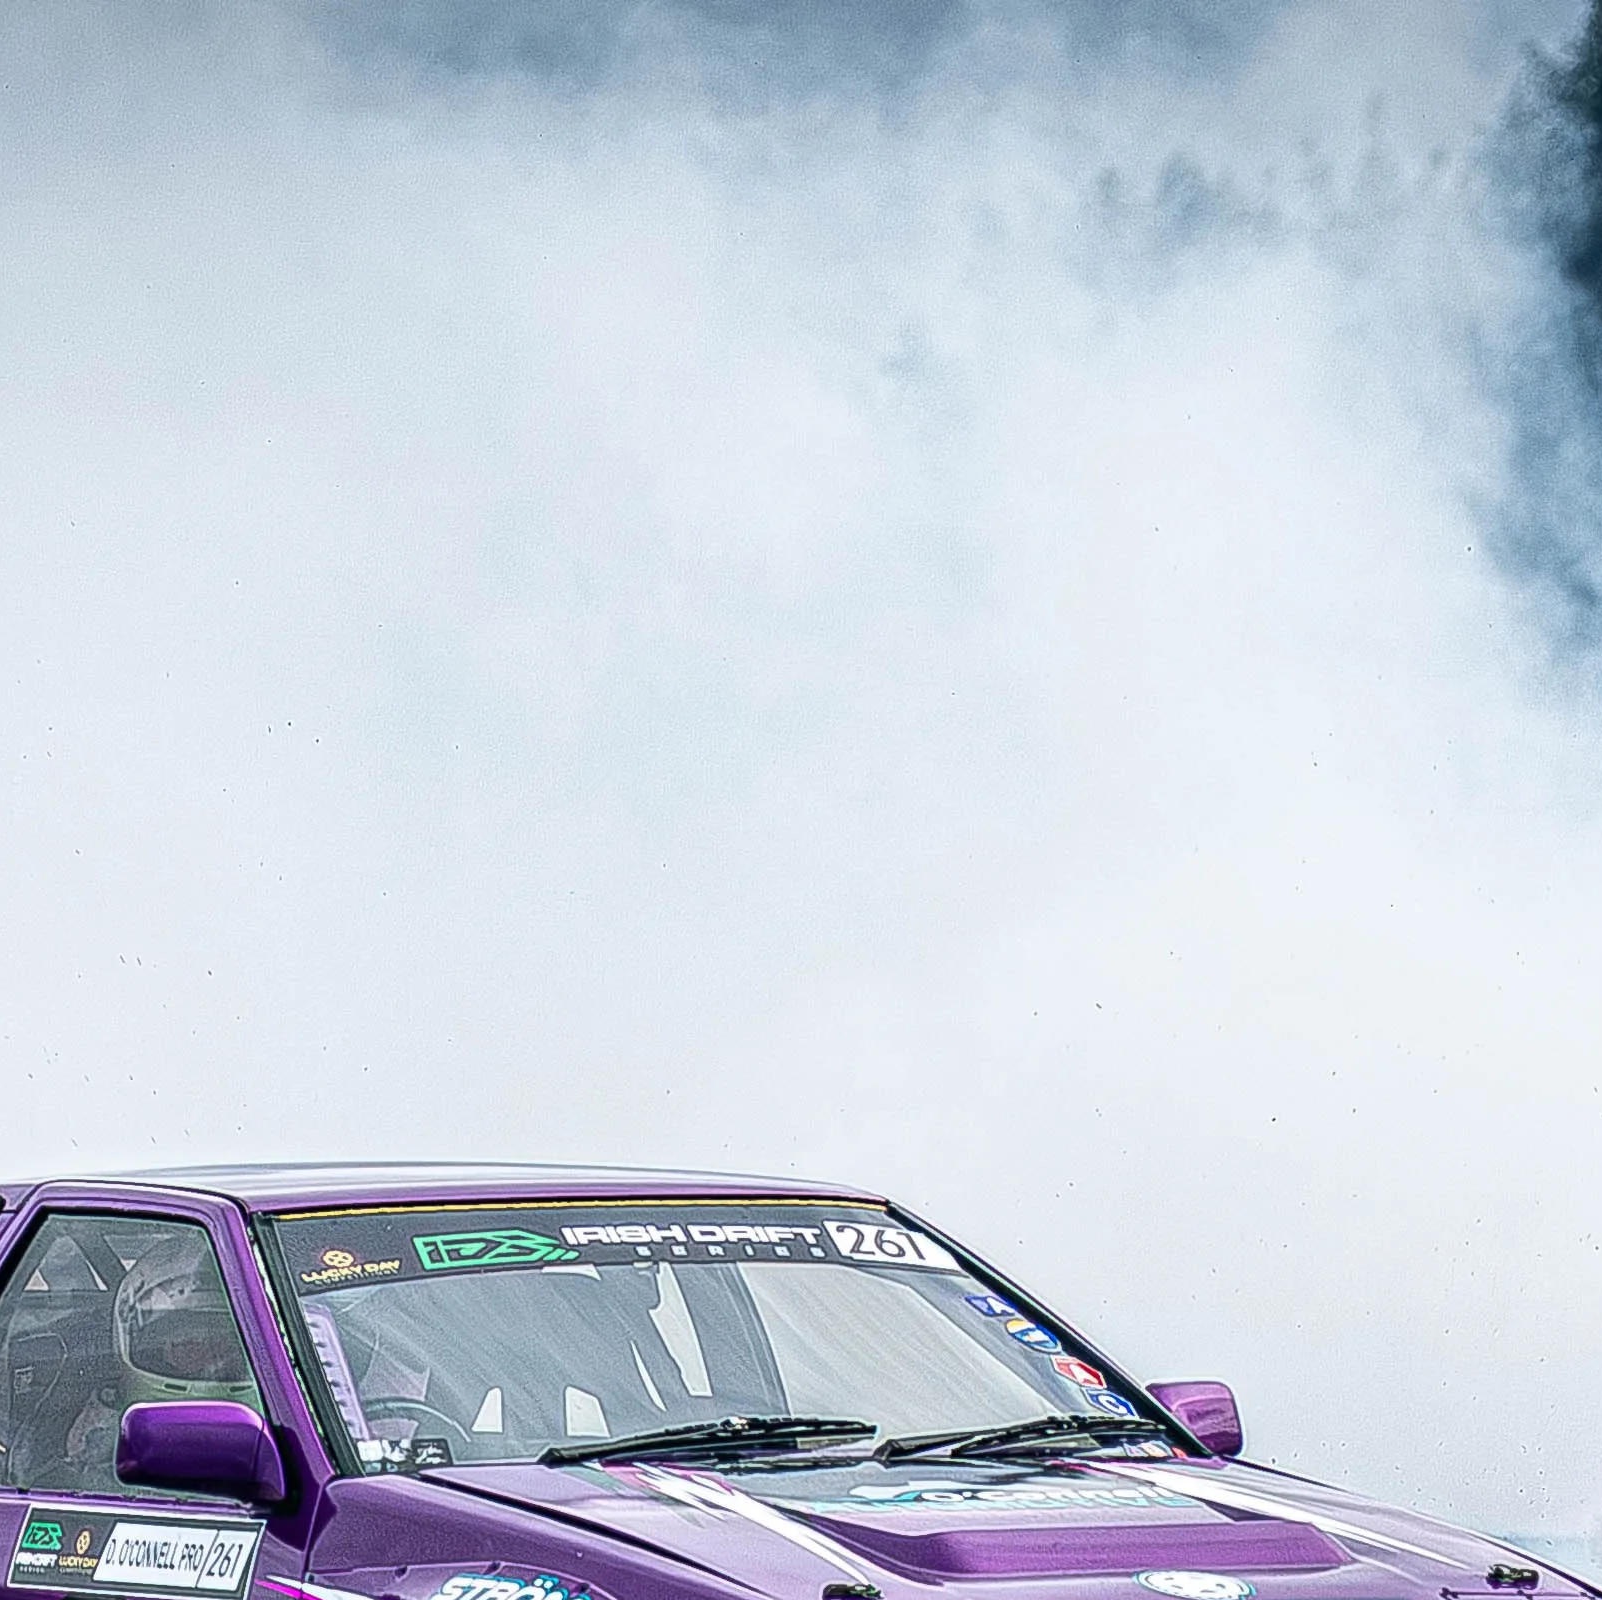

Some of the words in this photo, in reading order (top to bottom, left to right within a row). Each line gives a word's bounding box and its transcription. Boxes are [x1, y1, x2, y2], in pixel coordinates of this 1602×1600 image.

[561, 1225, 687, 1245] IRISH
[689, 1225, 821, 1246] DRIFT
[837, 1225, 925, 1260] 261
[105, 1539, 116, 1565] D.
[206, 1542, 243, 1578] 261
